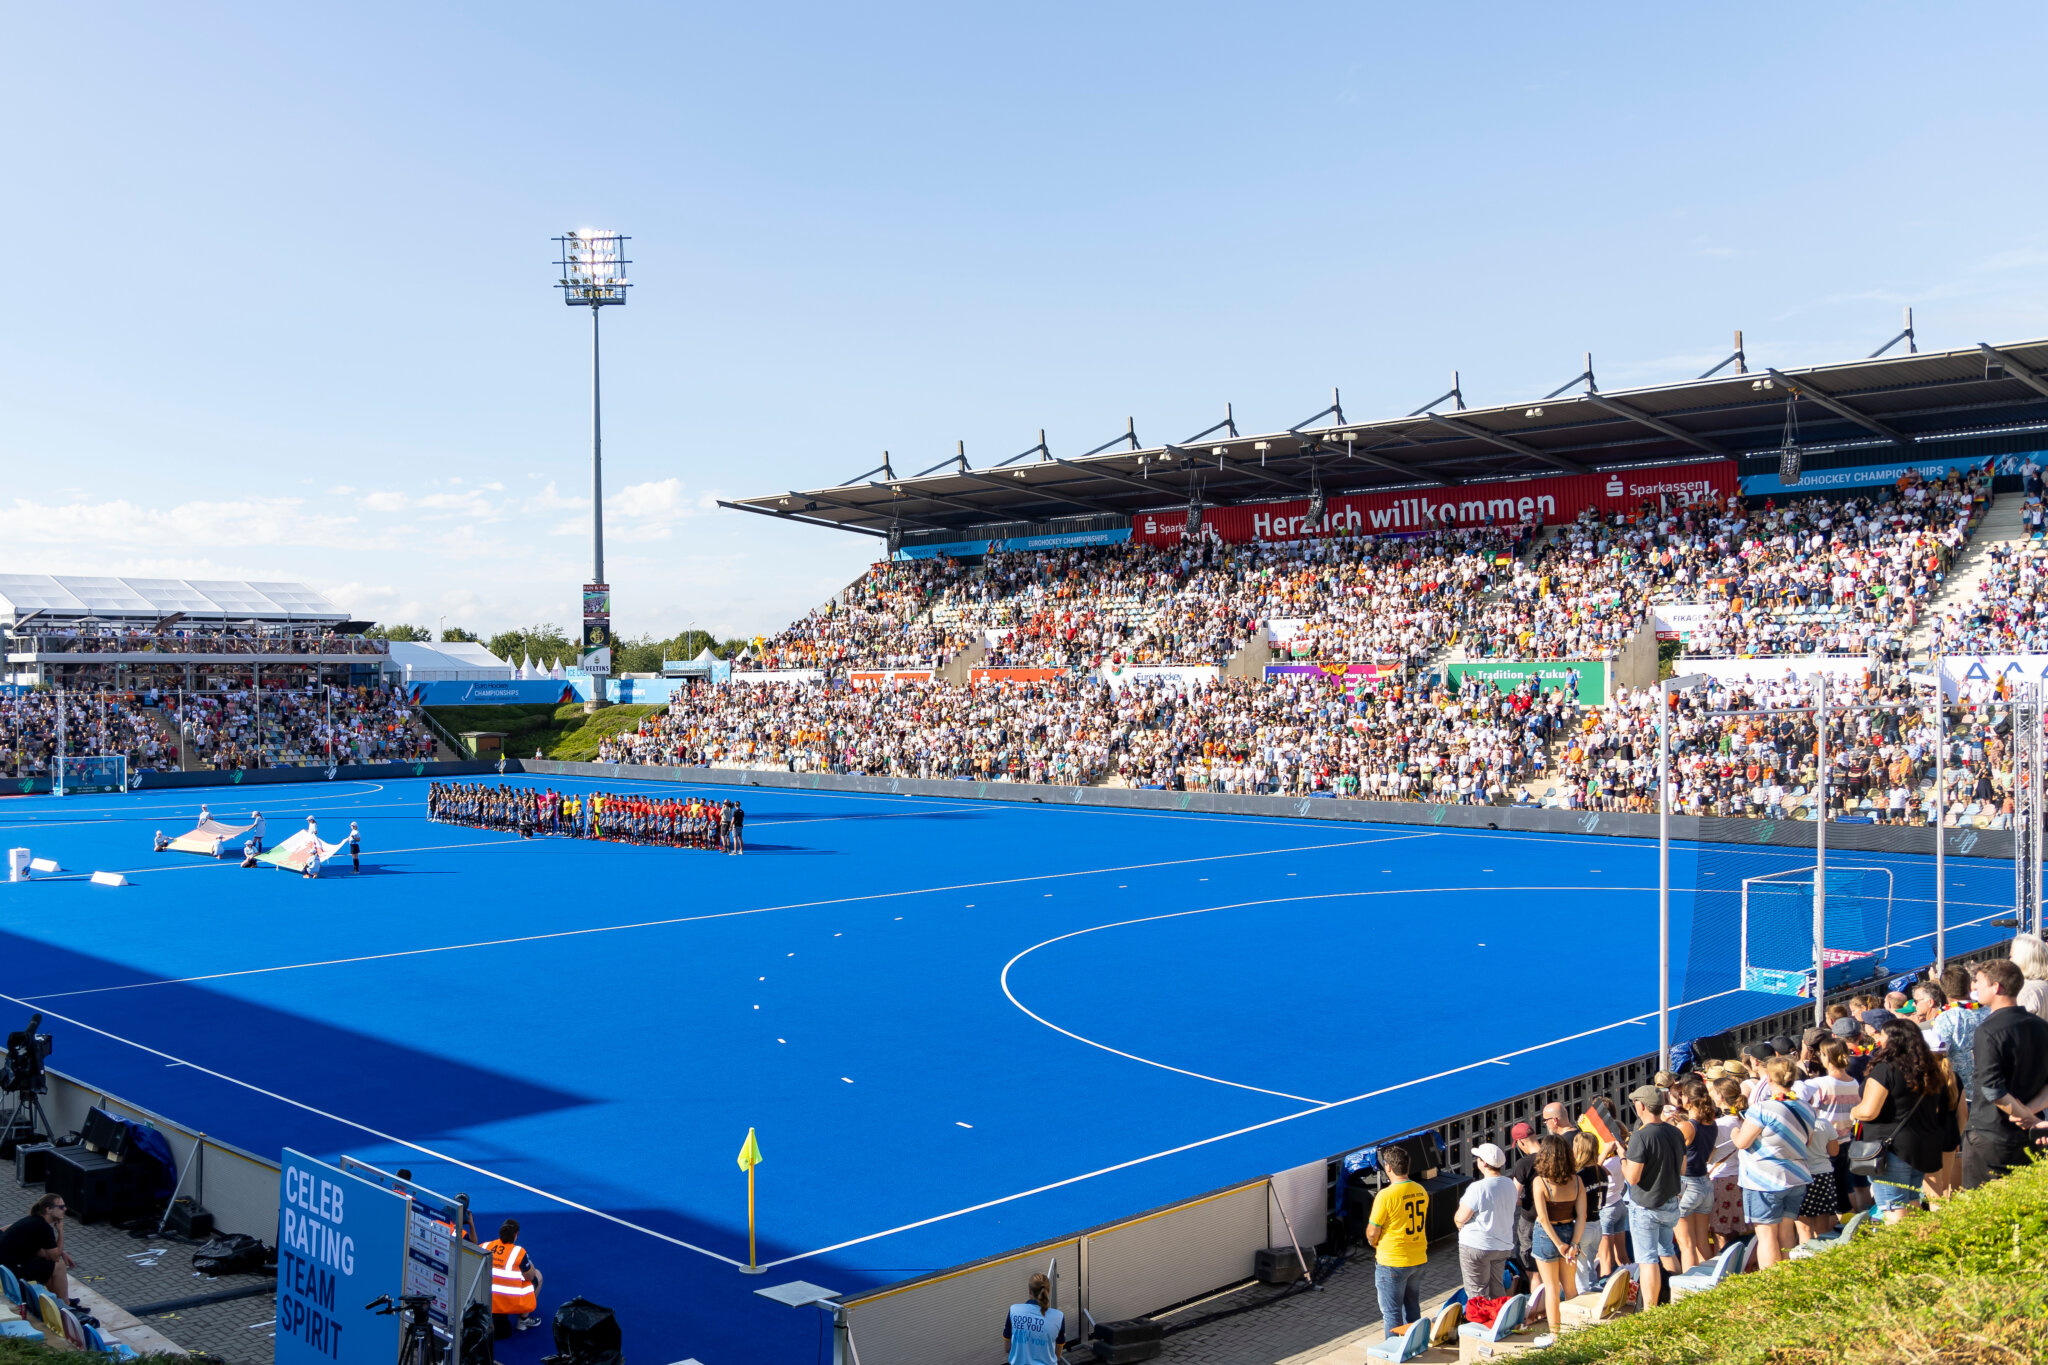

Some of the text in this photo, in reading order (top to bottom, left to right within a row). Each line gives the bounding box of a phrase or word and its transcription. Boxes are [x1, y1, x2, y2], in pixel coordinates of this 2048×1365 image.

[1785, 473, 1850, 487] ROHOCKEY
[1629, 481, 1703, 497] Sparkassen
[1253, 494, 1556, 537] Herzich willkommen
[1159, 521, 1208, 536] Sparkan
[1028, 534, 1109, 547] EUROHOCKEY CHAMPIONSHIPS
[1477, 670, 1524, 679] Tradition
[286, 1165, 344, 1225] CELEB
[1405, 1199, 1426, 1236] 35
[284, 1207, 355, 1276] RATING
[490, 1244, 505, 1256] 43
[283, 1250, 336, 1312] TEAM
[281, 1294, 343, 1361] SPIRIT
[1013, 1315, 1045, 1326] GOOD TO
[1013, 1322, 1025, 1330] SEE
